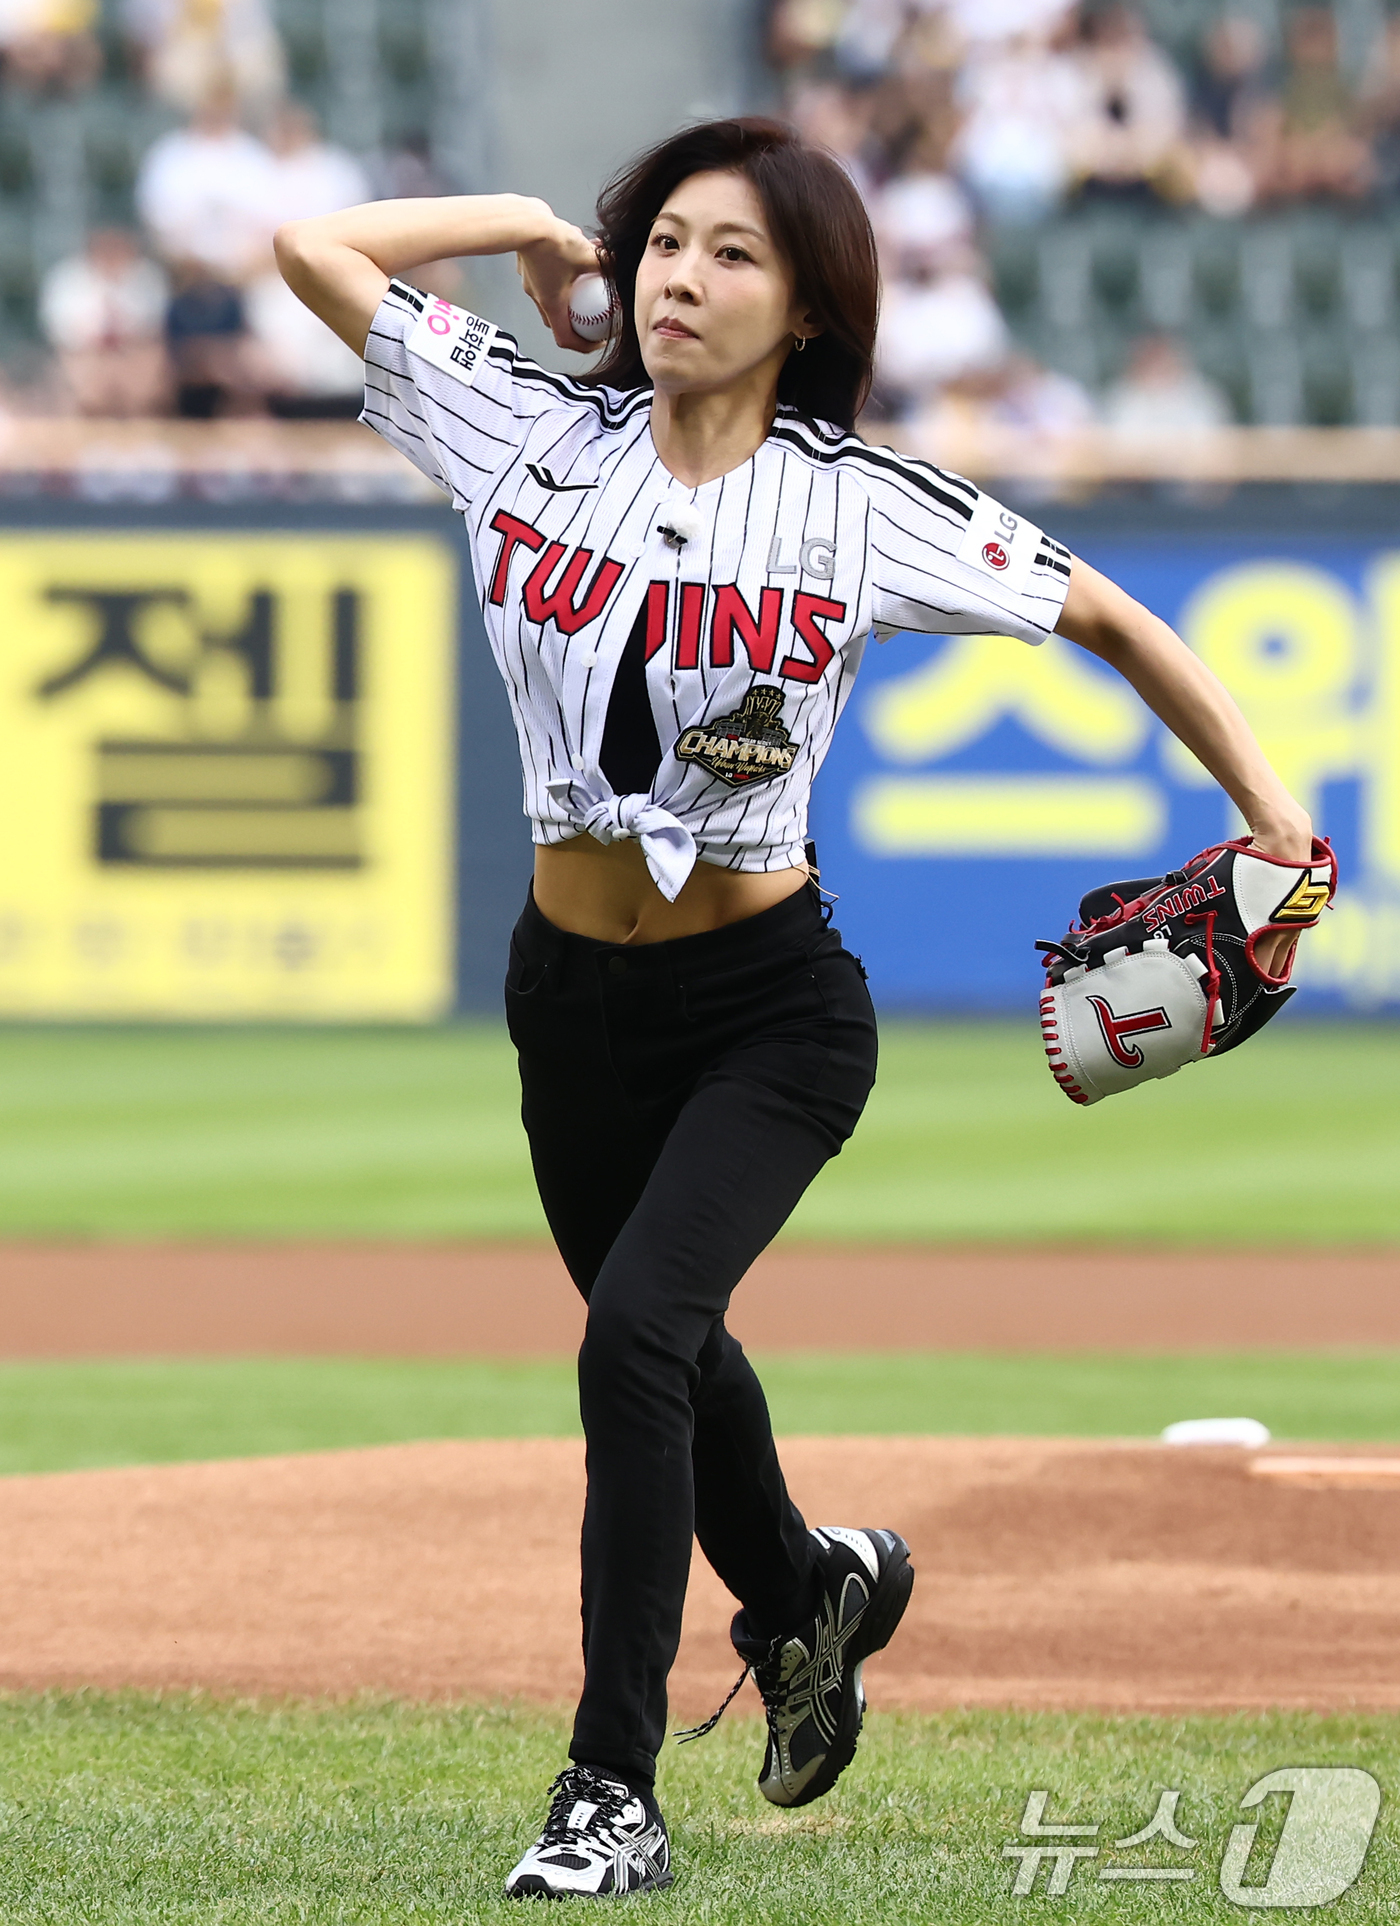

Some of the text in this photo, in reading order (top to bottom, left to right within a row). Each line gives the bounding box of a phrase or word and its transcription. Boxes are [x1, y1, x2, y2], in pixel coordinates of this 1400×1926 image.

[450, 315, 490, 371] 통화앱
[994, 512, 1018, 544] LG
[766, 535, 837, 580] LG
[489, 508, 847, 684] TWINS
[37, 582, 366, 868] 젤
[679, 731, 796, 768] CHAMPIONS
[1142, 875, 1225, 932] TWINS
[1154, 925, 1172, 940] LG
